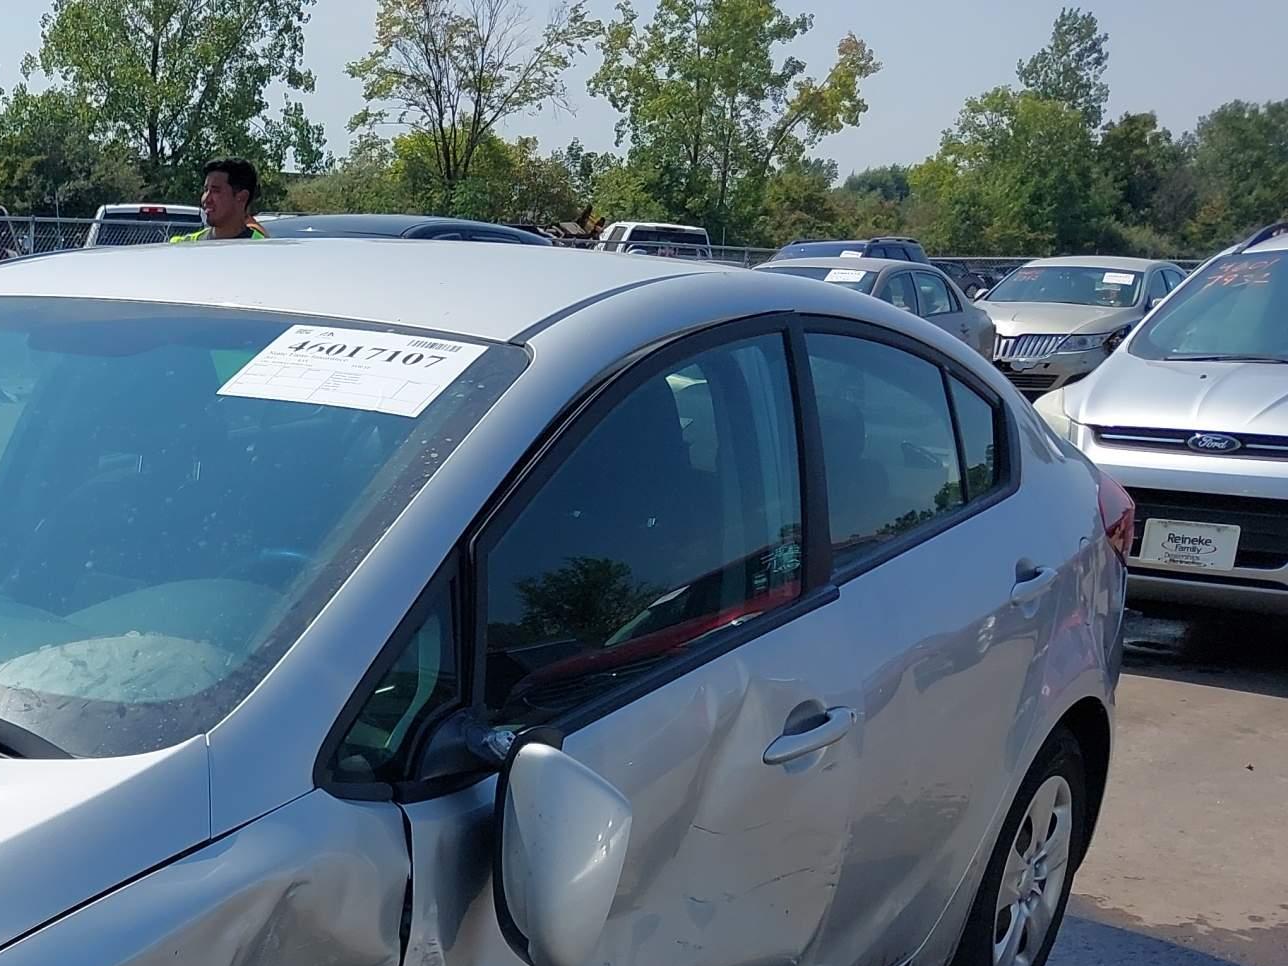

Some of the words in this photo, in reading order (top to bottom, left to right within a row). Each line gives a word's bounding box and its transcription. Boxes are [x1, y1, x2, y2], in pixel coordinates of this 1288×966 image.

[288, 340, 447, 368] 46017107
[1198, 436, 1228, 449] Ford
[1167, 532, 1212, 547] Reineke
[1174, 543, 1202, 555] Family
